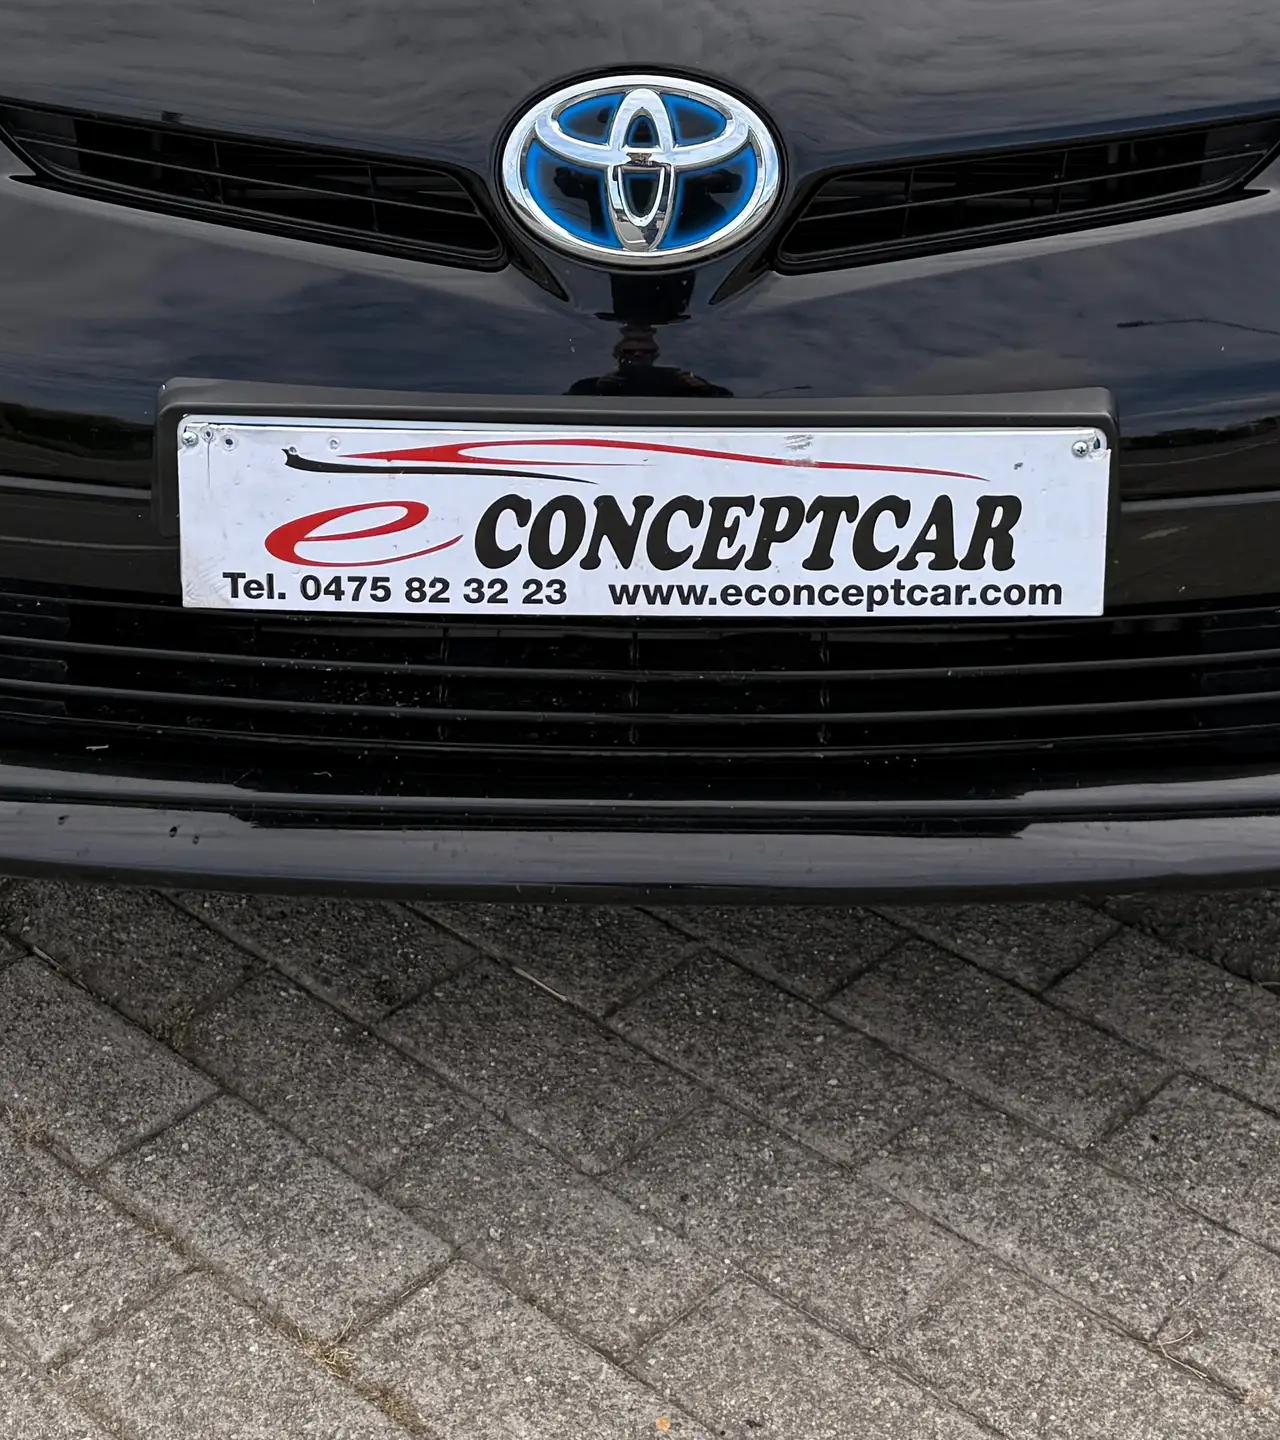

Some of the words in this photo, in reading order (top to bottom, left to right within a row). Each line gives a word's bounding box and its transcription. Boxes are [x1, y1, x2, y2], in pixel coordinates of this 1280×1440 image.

[264, 500, 463, 567] e
[474, 494, 1022, 571] CONCEPTCAR
[223, 572, 286, 600] Tel.
[299, 575, 392, 602] 0475
[404, 576, 450, 603] 82
[463, 577, 508, 604] 32
[522, 578, 567, 605] 23
[608, 579, 1062, 612] www.econceptcar.com
